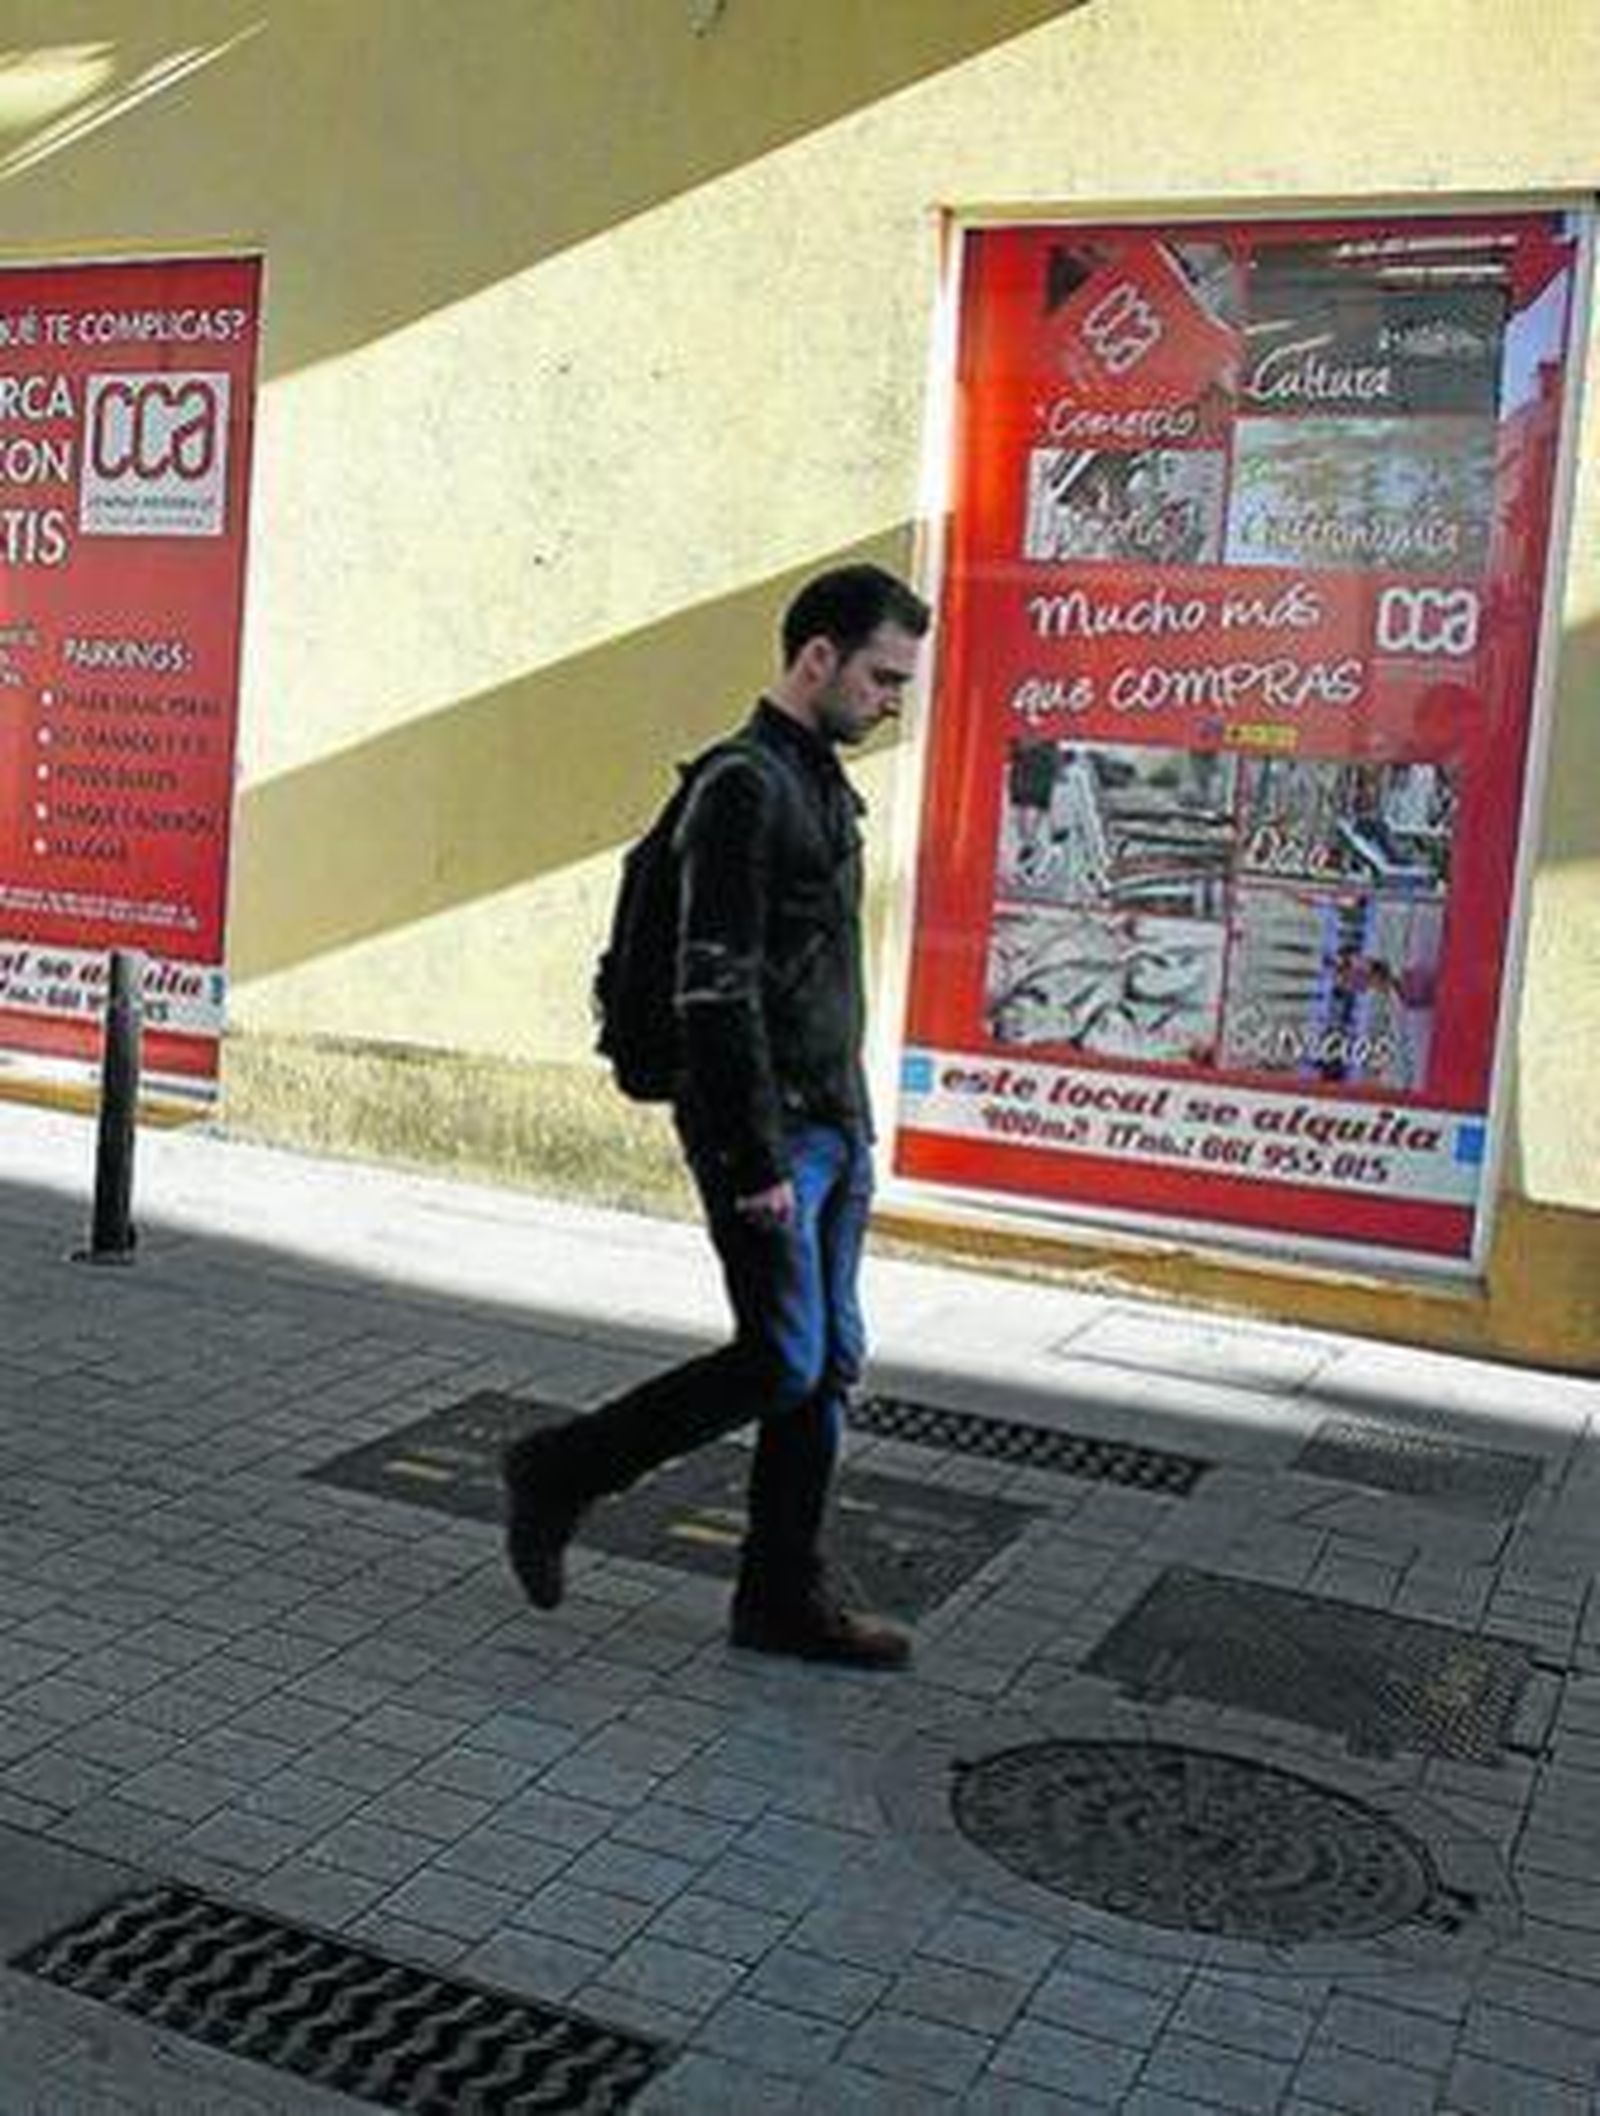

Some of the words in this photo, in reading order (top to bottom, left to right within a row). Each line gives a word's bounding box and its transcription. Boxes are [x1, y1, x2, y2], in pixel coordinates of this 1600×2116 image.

[44, 313, 71, 343] TE
[78, 308, 245, 345] COMPLICAS?
[1246, 334, 1390, 398] Cultura
[92, 379, 217, 480] cca
[1048, 398, 1197, 437] Comercio
[1028, 586, 1206, 637] Mucho
[1221, 584, 1320, 628] más
[1377, 586, 1479, 655] cca
[63, 637, 193, 671] PARKINGS:
[1012, 676, 1094, 726] que
[1110, 658, 1363, 710] COMPRAS
[941, 1067, 1036, 1101] este
[1047, 1076, 1170, 1118] local
[1184, 1100, 1239, 1124] se
[1252, 1106, 1442, 1151] alquila
[1202, 1136, 1253, 1165] 661
